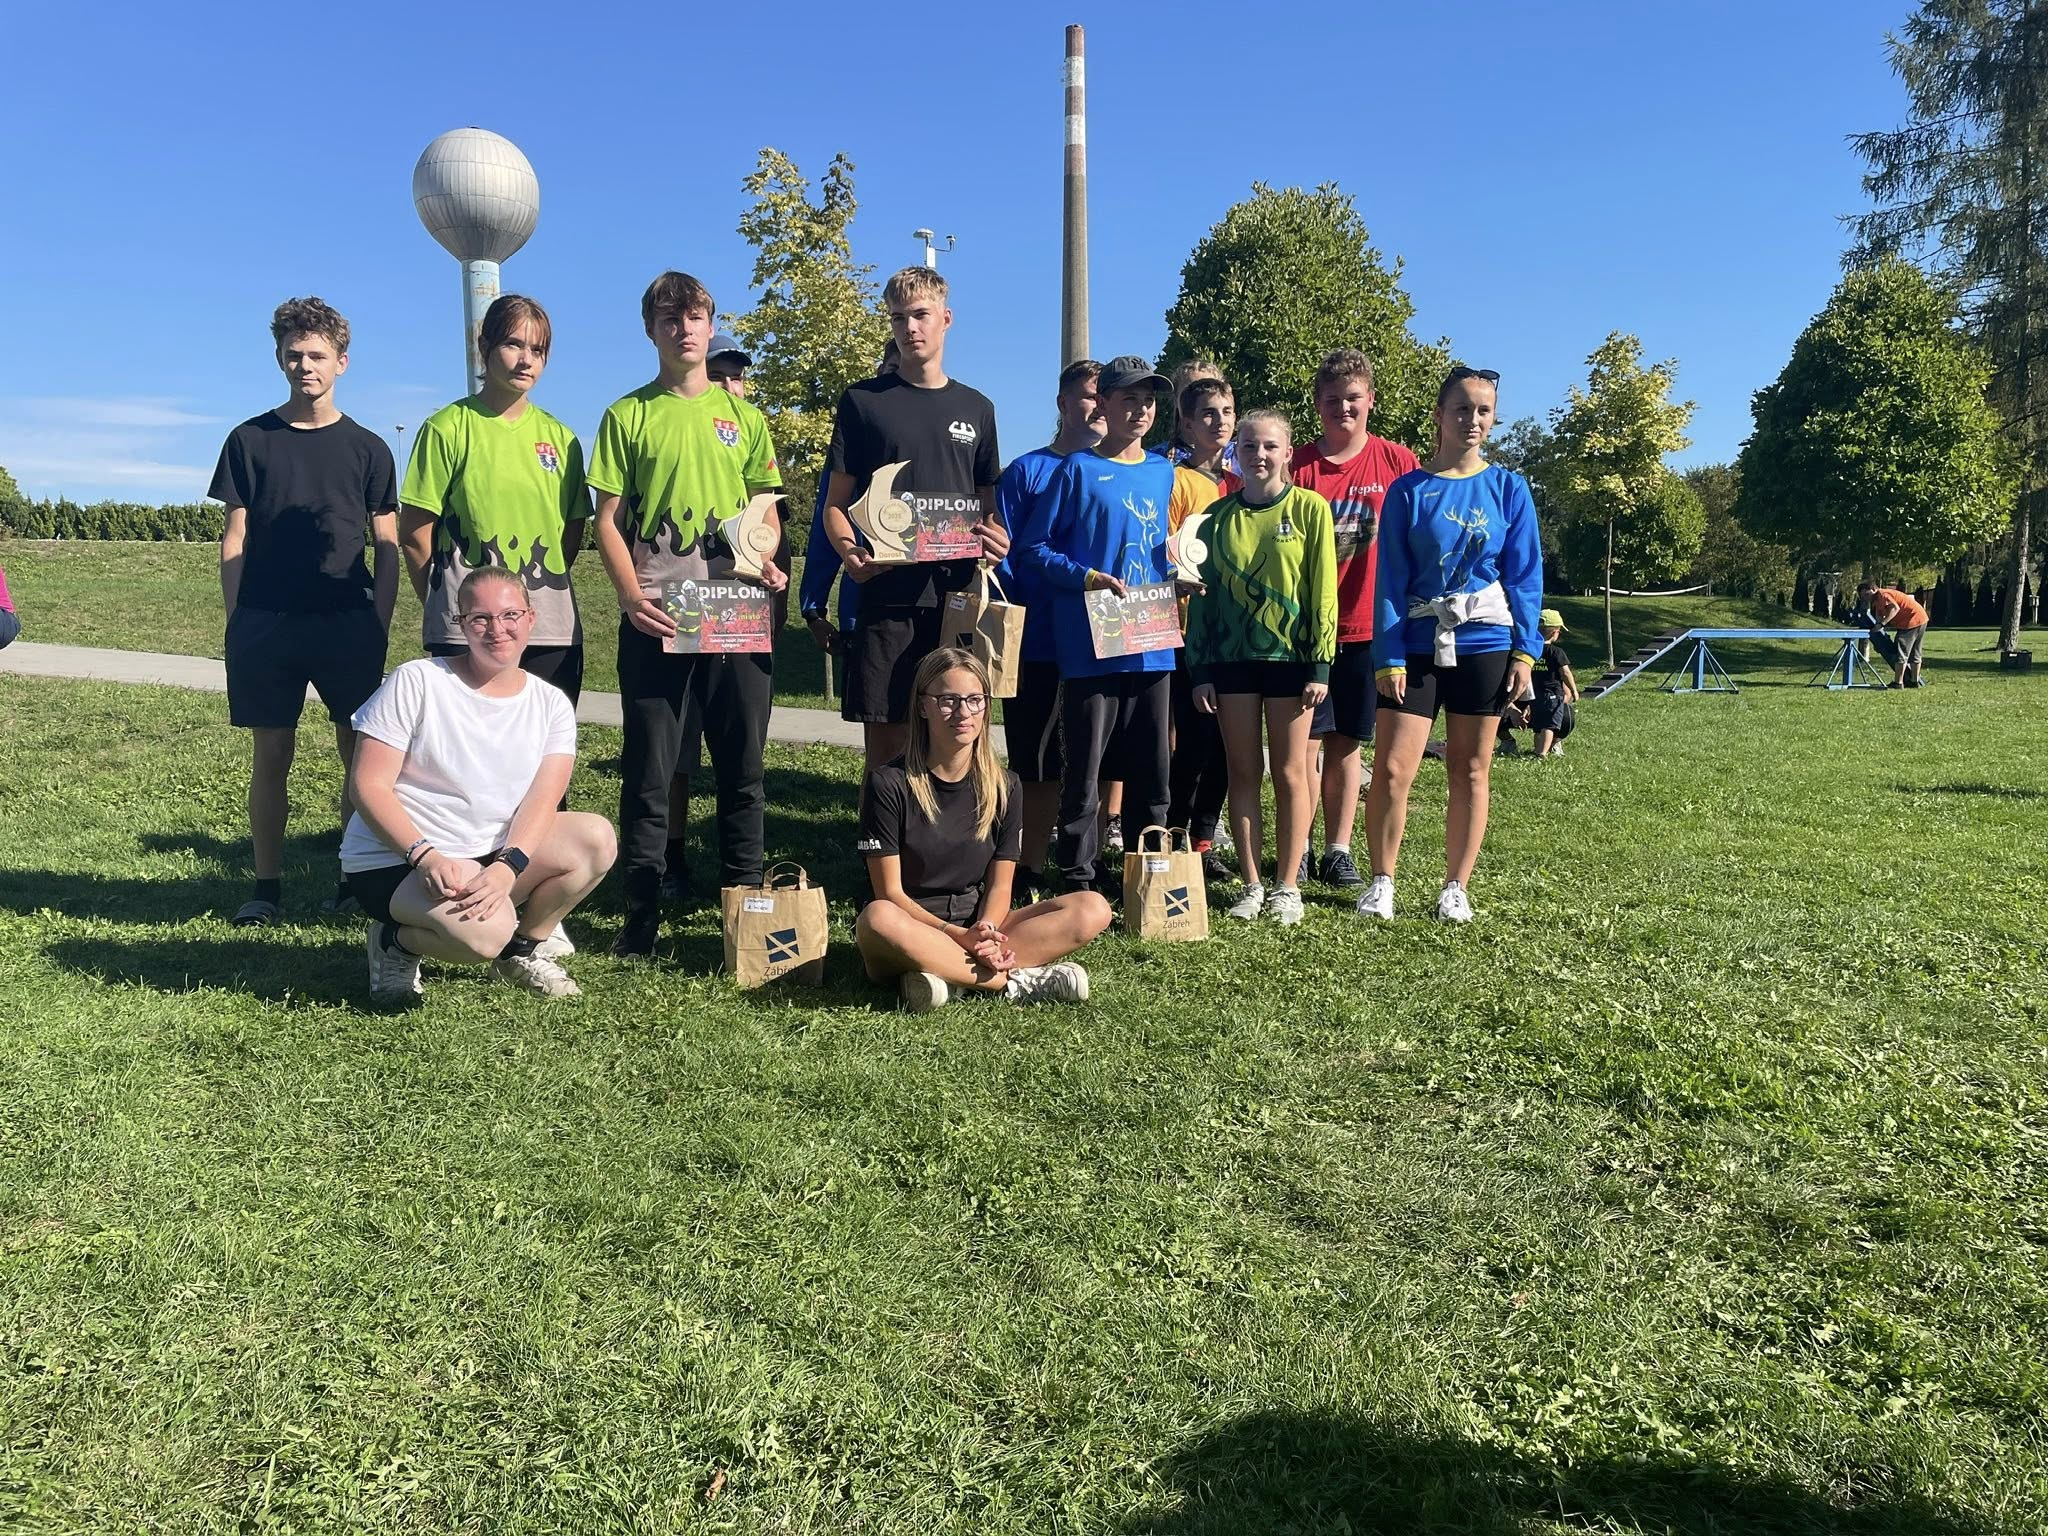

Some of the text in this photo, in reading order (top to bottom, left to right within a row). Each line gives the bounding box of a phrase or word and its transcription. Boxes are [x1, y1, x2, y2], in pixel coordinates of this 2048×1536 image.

[1349, 482, 1384, 496] Pepča
[917, 498, 980, 512] DIPLOM
[698, 586, 766, 599] DIPLOM
[1163, 920, 1190, 929] Zábřeh
